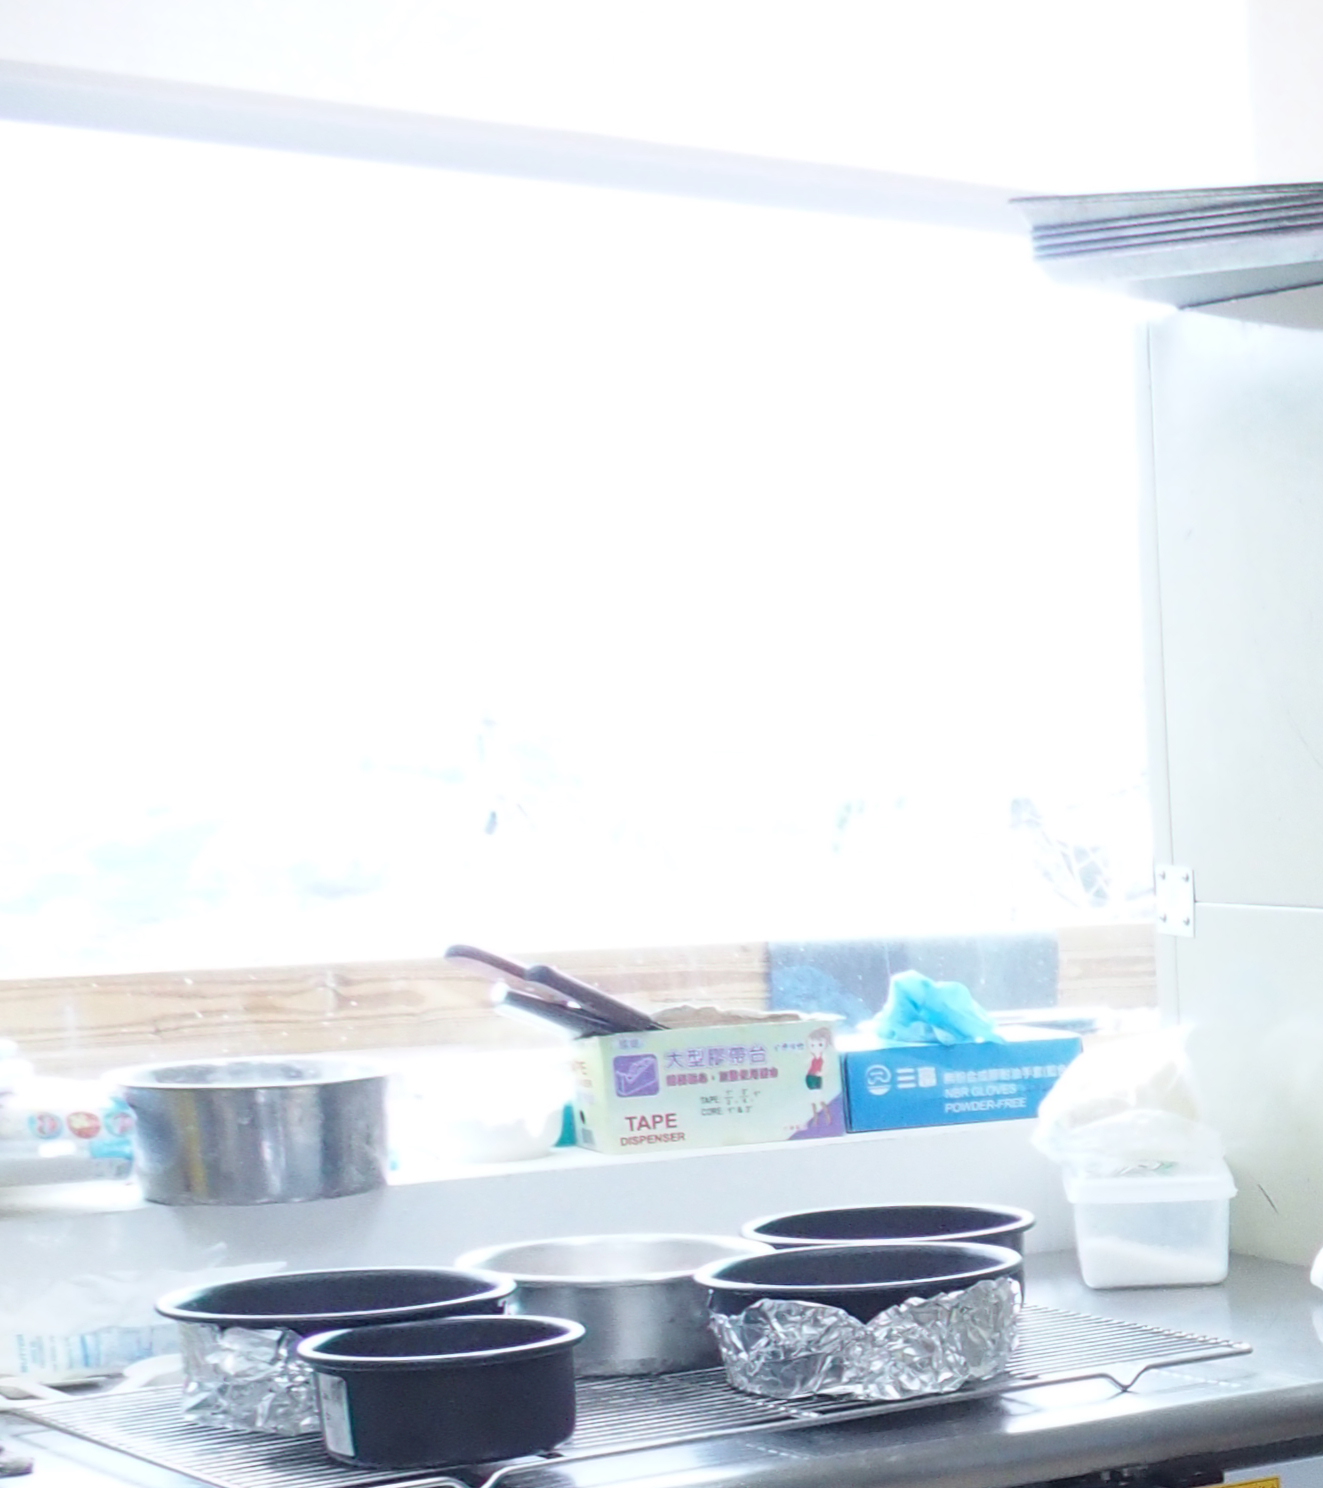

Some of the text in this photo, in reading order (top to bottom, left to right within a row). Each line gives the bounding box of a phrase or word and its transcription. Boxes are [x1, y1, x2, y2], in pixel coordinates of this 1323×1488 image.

[971, 1083, 1017, 1097] GLOVES
[944, 1097, 1027, 1113] POWDER-FREE
[625, 1113, 678, 1131] TAPE
[620, 1132, 686, 1147] DISPENSER
